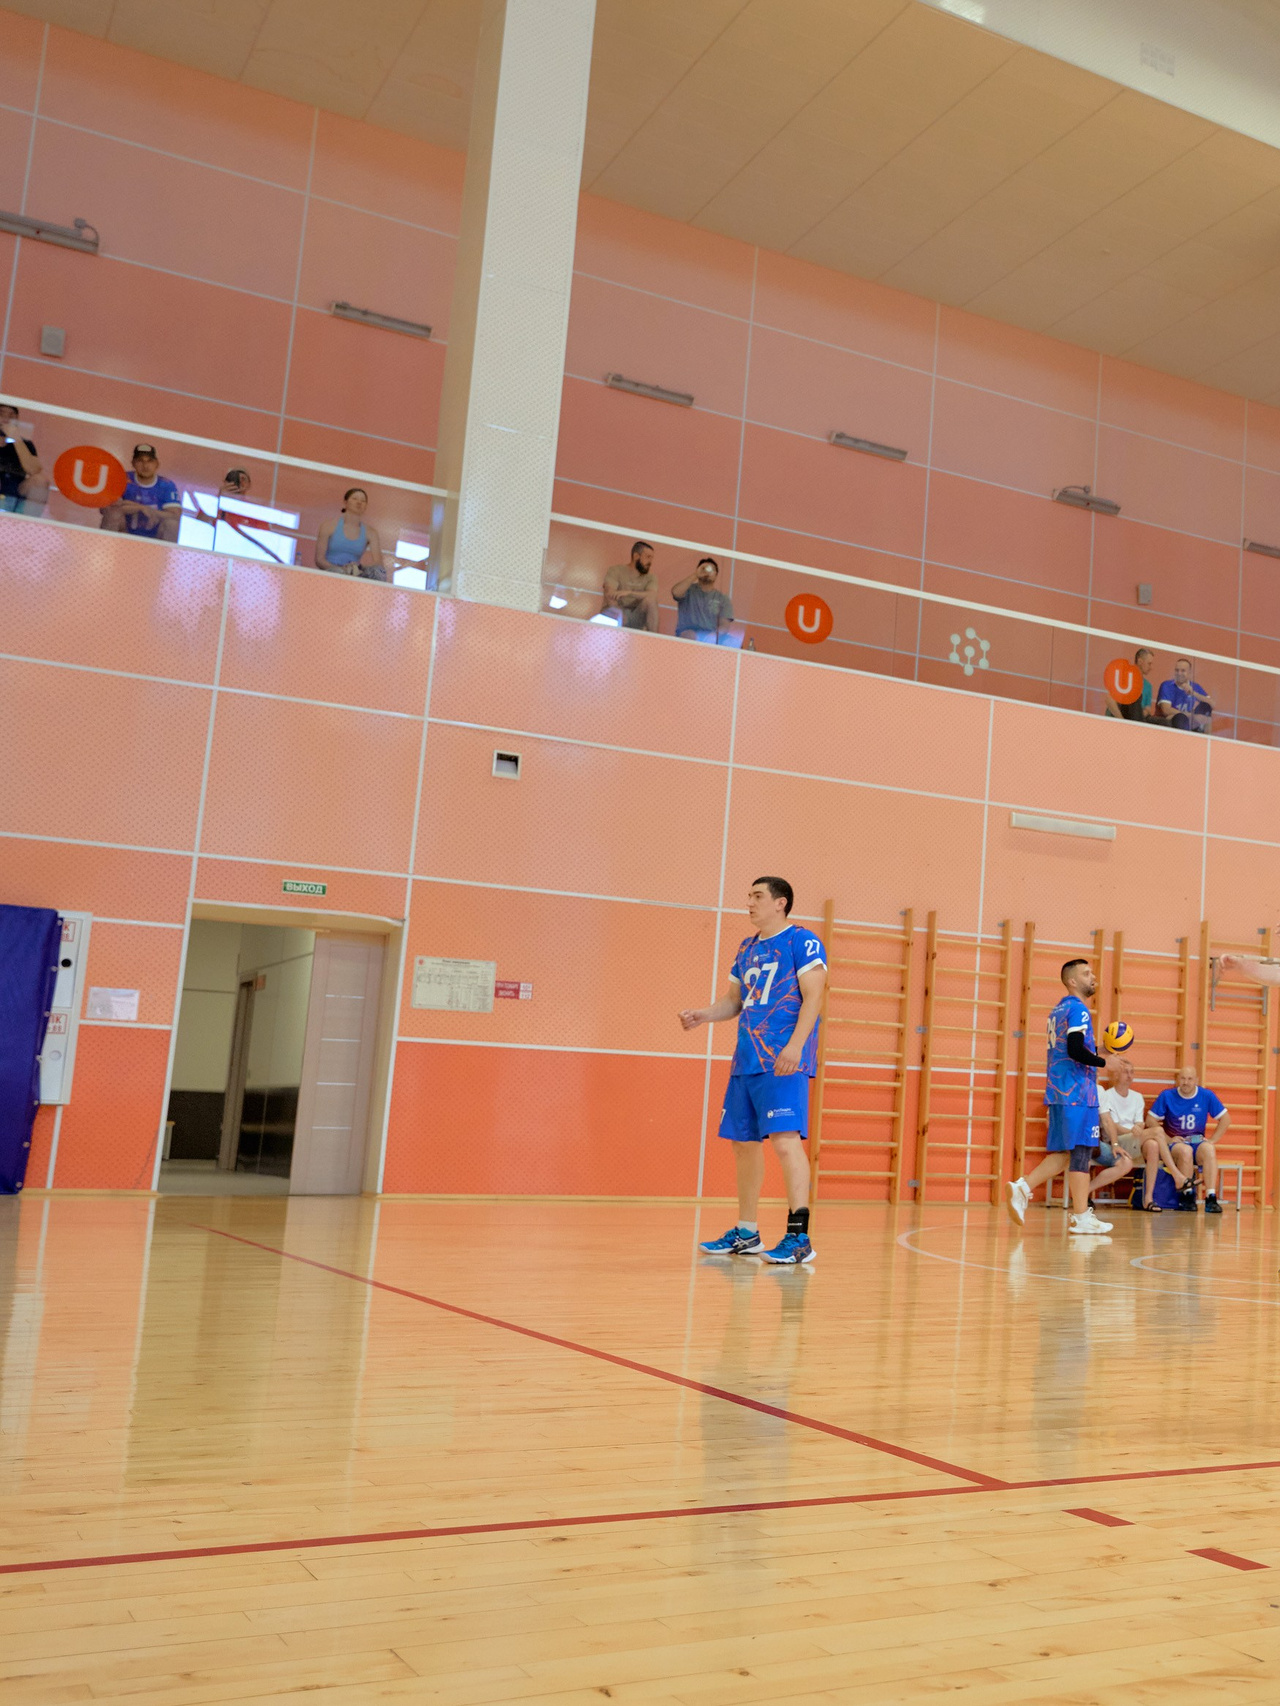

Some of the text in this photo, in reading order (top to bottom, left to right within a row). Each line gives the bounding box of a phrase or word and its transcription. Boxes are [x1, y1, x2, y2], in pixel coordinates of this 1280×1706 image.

[73, 459, 109, 494] U
[797, 605, 821, 633] U
[1114, 669, 1133, 694] U
[286, 883, 323, 894] ВЫХОД
[804, 939, 820, 957] 27
[743, 962, 779, 1010] 27
[1178, 1114, 1196, 1130] 18
